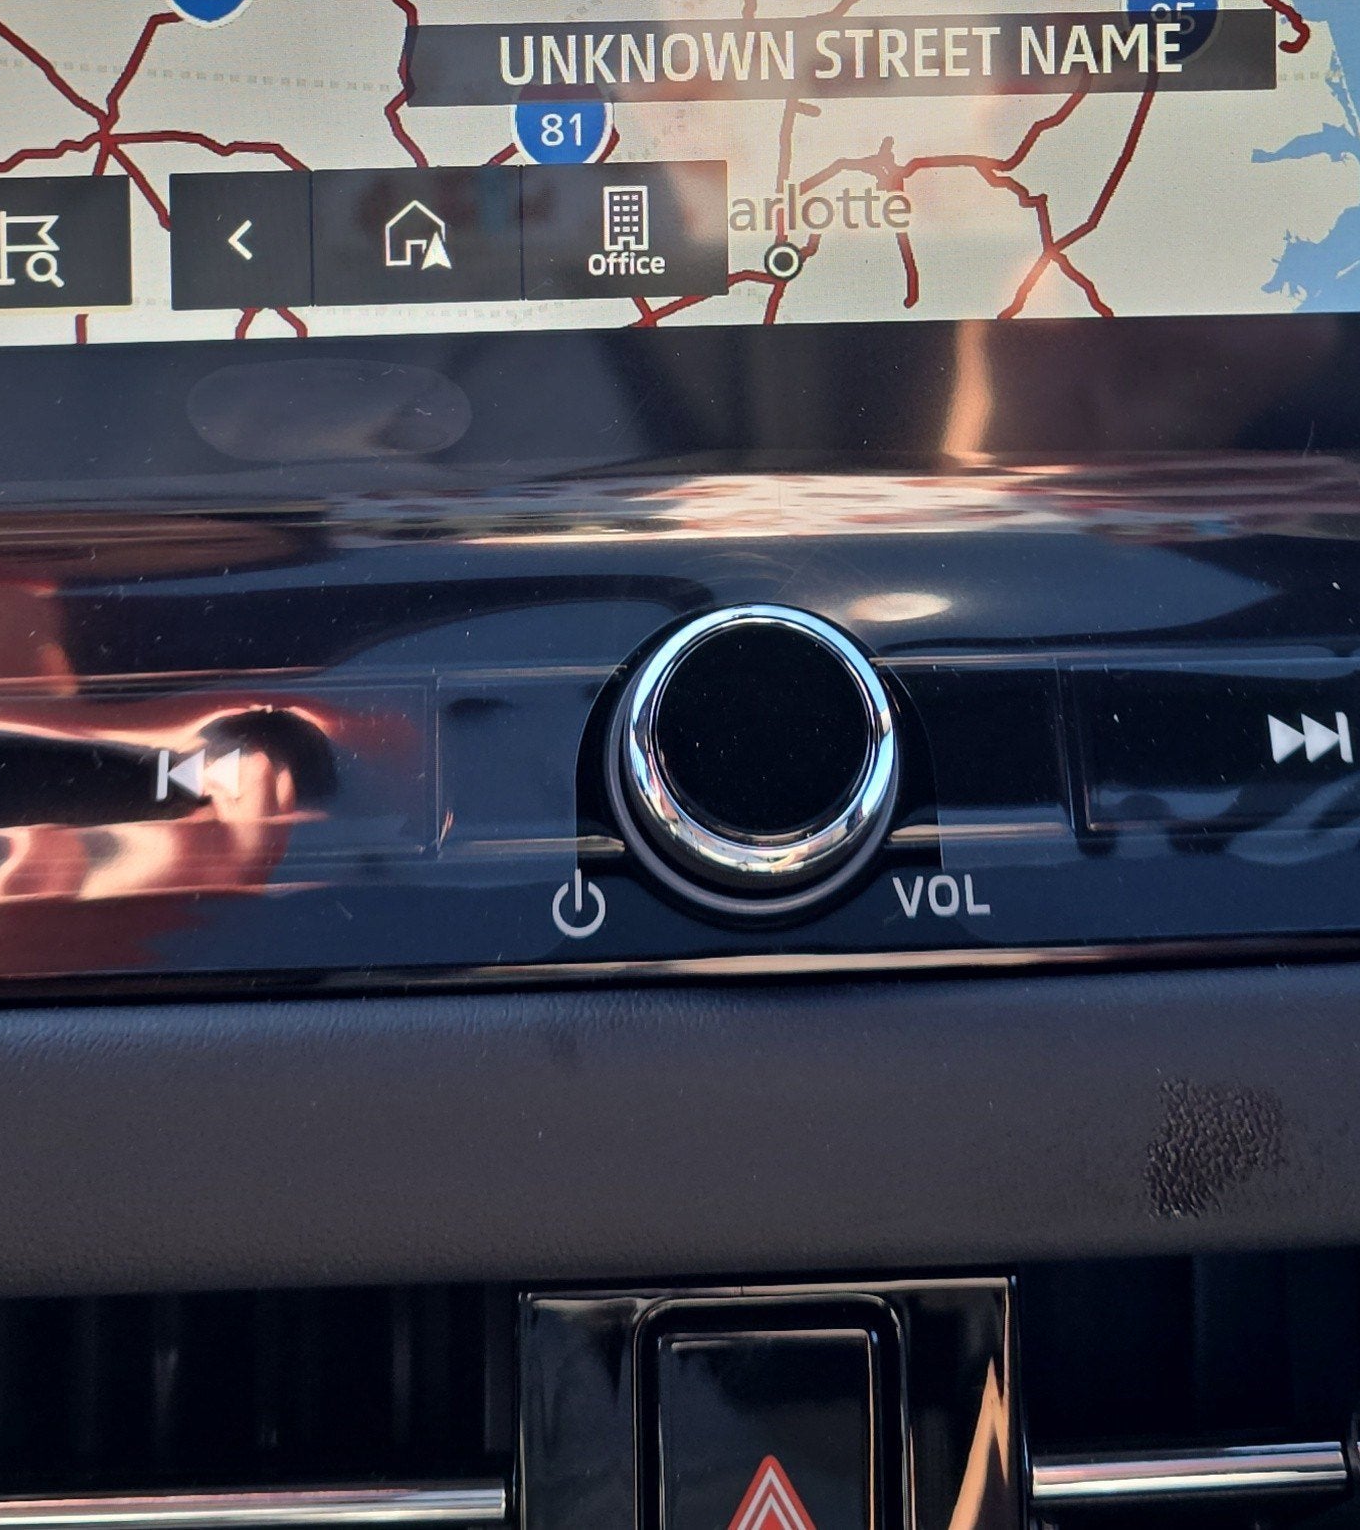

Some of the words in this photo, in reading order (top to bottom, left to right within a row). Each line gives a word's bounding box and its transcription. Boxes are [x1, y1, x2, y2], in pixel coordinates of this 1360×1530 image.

[499, 29, 796, 87] UNKNOWN
[814, 27, 1002, 80] STREET
[1020, 22, 1184, 75] NAME
[541, 113, 583, 147] 81
[729, 183, 912, 232] arlotte
[588, 253, 665, 277] Office
[892, 875, 991, 917] VOL
